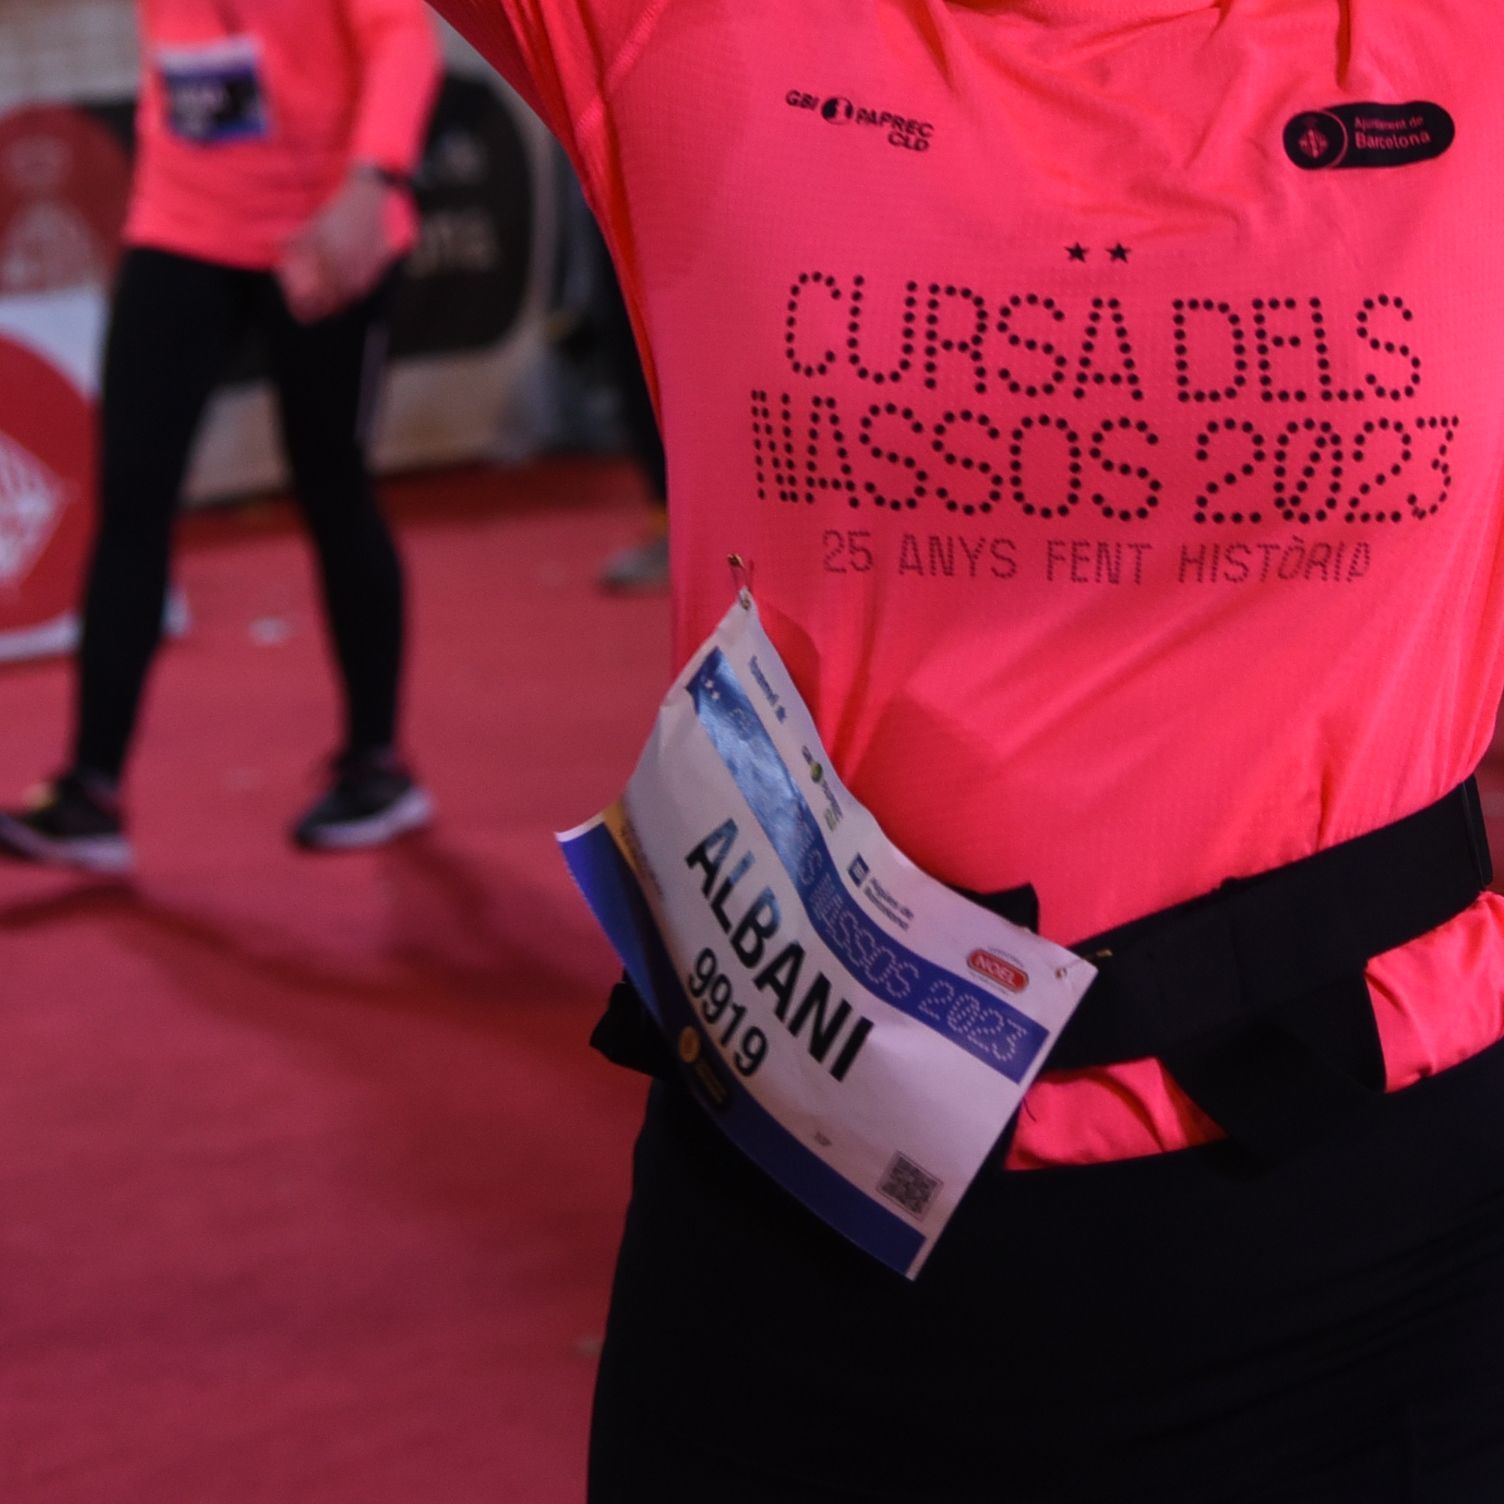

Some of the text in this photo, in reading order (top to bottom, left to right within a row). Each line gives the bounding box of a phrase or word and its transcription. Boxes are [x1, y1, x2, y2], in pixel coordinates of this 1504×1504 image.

[856, 108, 935, 138] PAPREC
[887, 131, 930, 152] CLD
[1354, 129, 1433, 150] Barcelona
[785, 271, 1422, 401] CURSA DELS
[750, 388, 1460, 524] NASSOS 2023
[822, 531, 874, 577] 25
[898, 533, 1020, 581] ANYS
[1045, 538, 1154, 586] FENT
[685, 817, 874, 1082] ALBANI
[688, 946, 769, 1077] 9919
